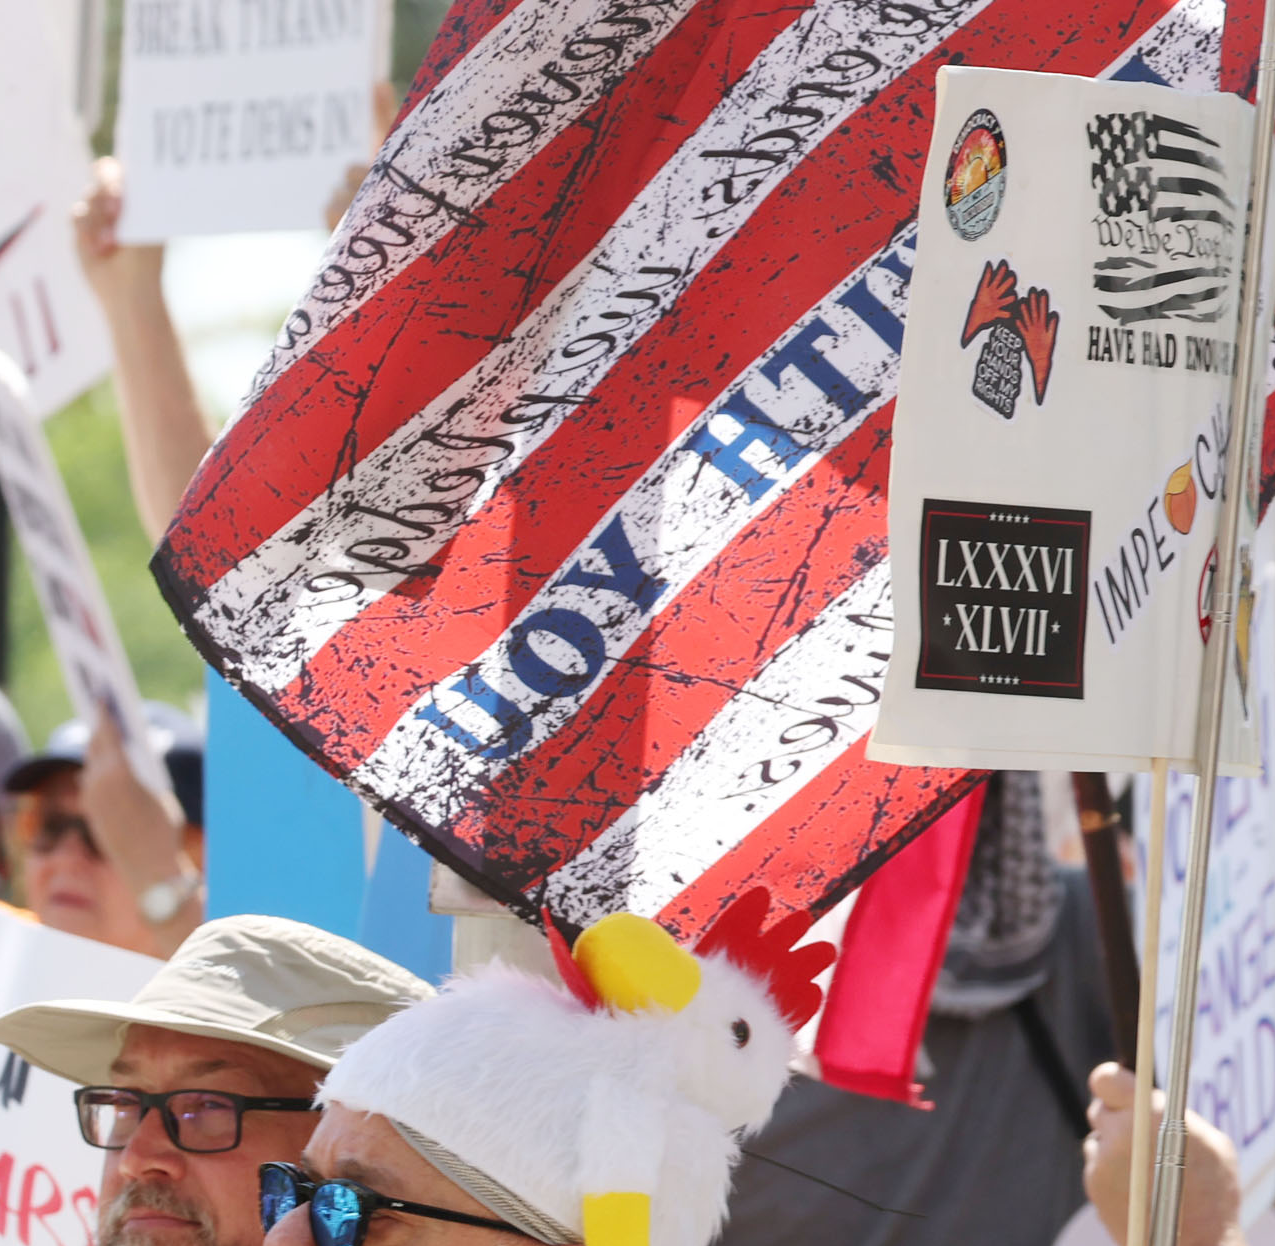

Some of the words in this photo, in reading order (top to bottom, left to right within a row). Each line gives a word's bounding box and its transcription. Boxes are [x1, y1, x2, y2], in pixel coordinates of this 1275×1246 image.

[990, 336, 1021, 369] YOUR
[994, 323, 1023, 350] KEEP
[1087, 325, 1135, 365] HAVE
[1142, 330, 1176, 369] HAD
[977, 363, 1000, 386] OFF
[999, 379, 1019, 399] MY
[981, 348, 1022, 385] HANDS
[975, 377, 1013, 413] RIGHTS
[935, 538, 1075, 597] LXXXVI
[954, 603, 1050, 657] XLVII
